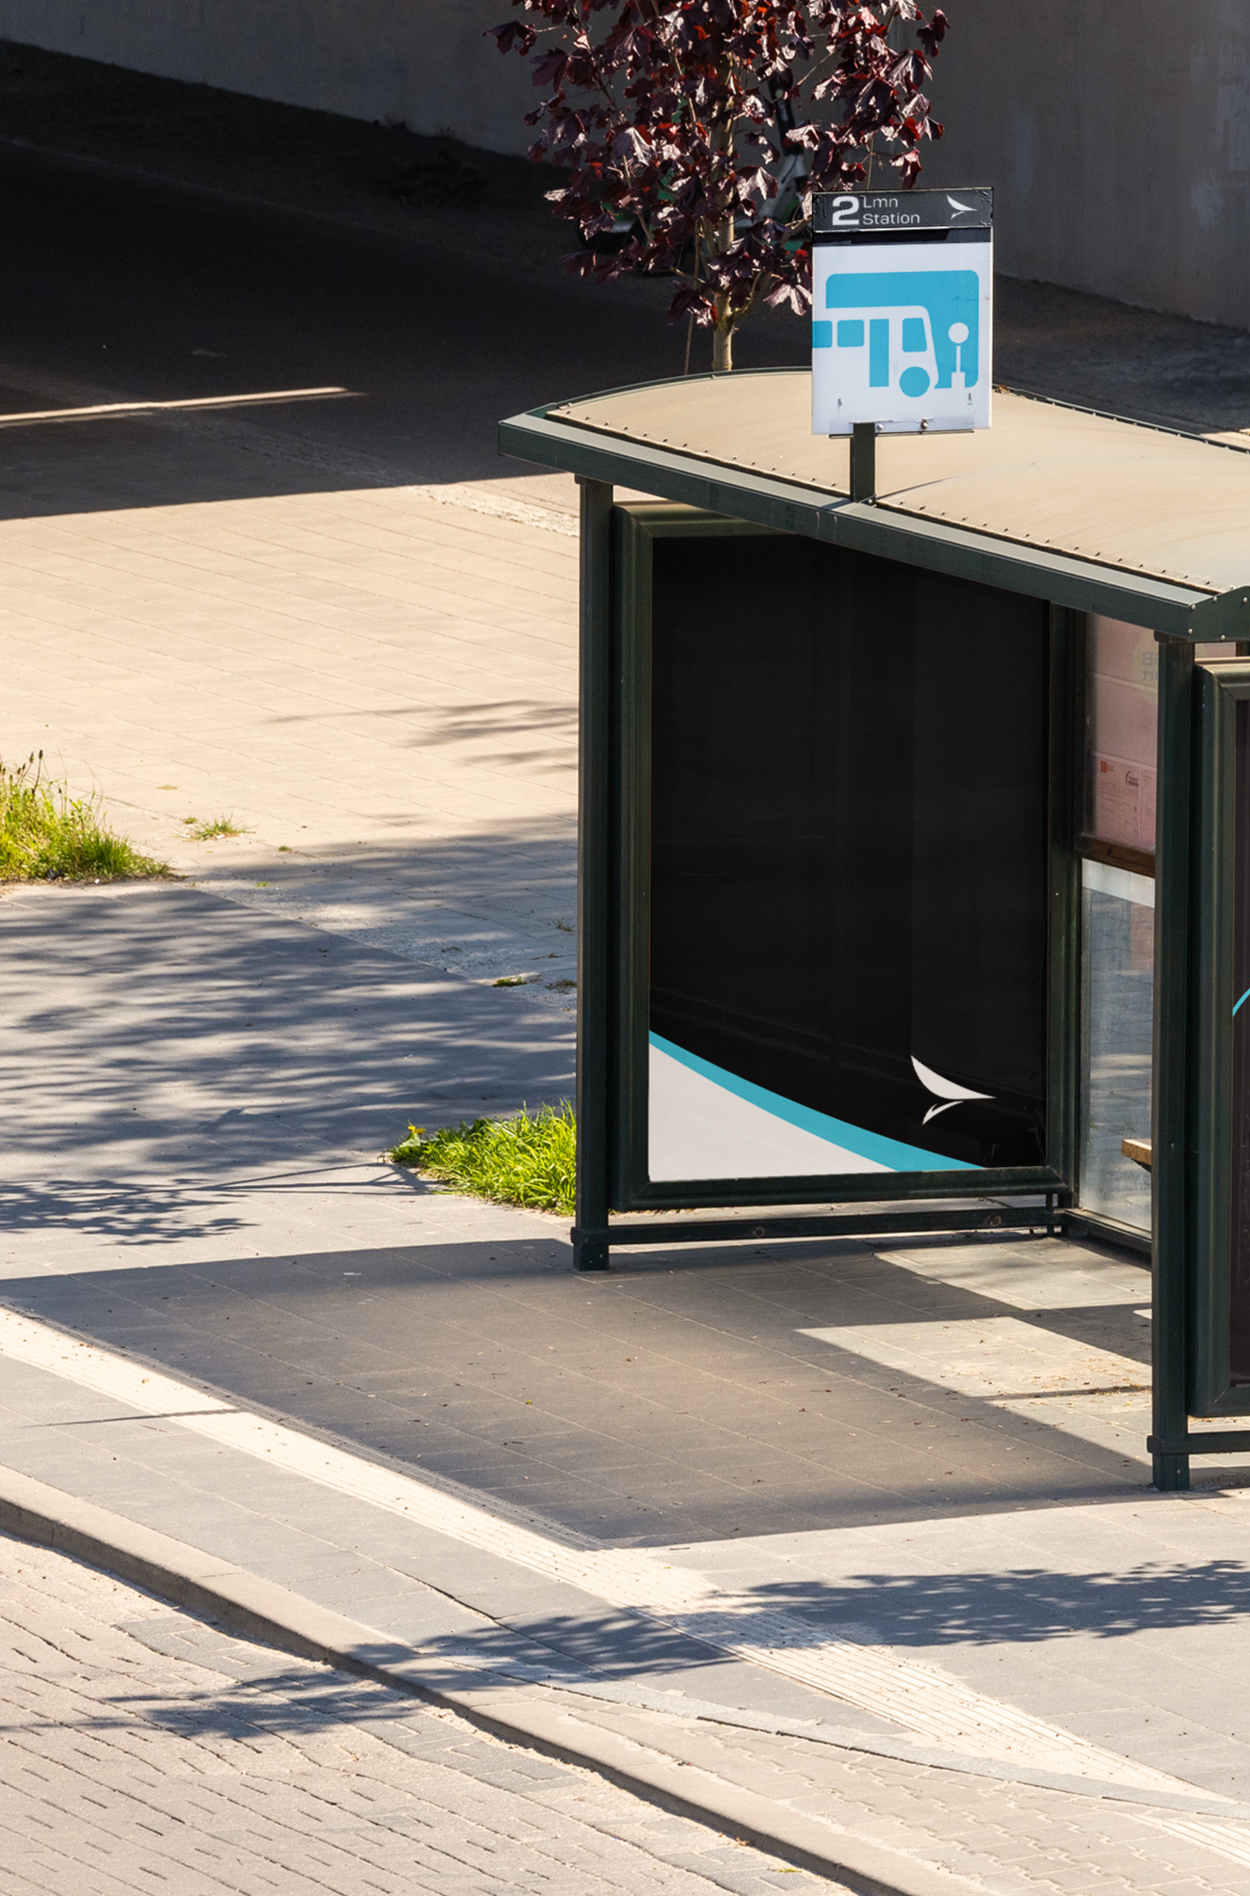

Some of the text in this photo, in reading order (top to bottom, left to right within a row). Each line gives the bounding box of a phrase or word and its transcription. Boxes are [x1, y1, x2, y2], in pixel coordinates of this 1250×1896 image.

[862, 195, 899, 209] Lmn
[832, 195, 860, 226] 2
[862, 212, 921, 225] Station
